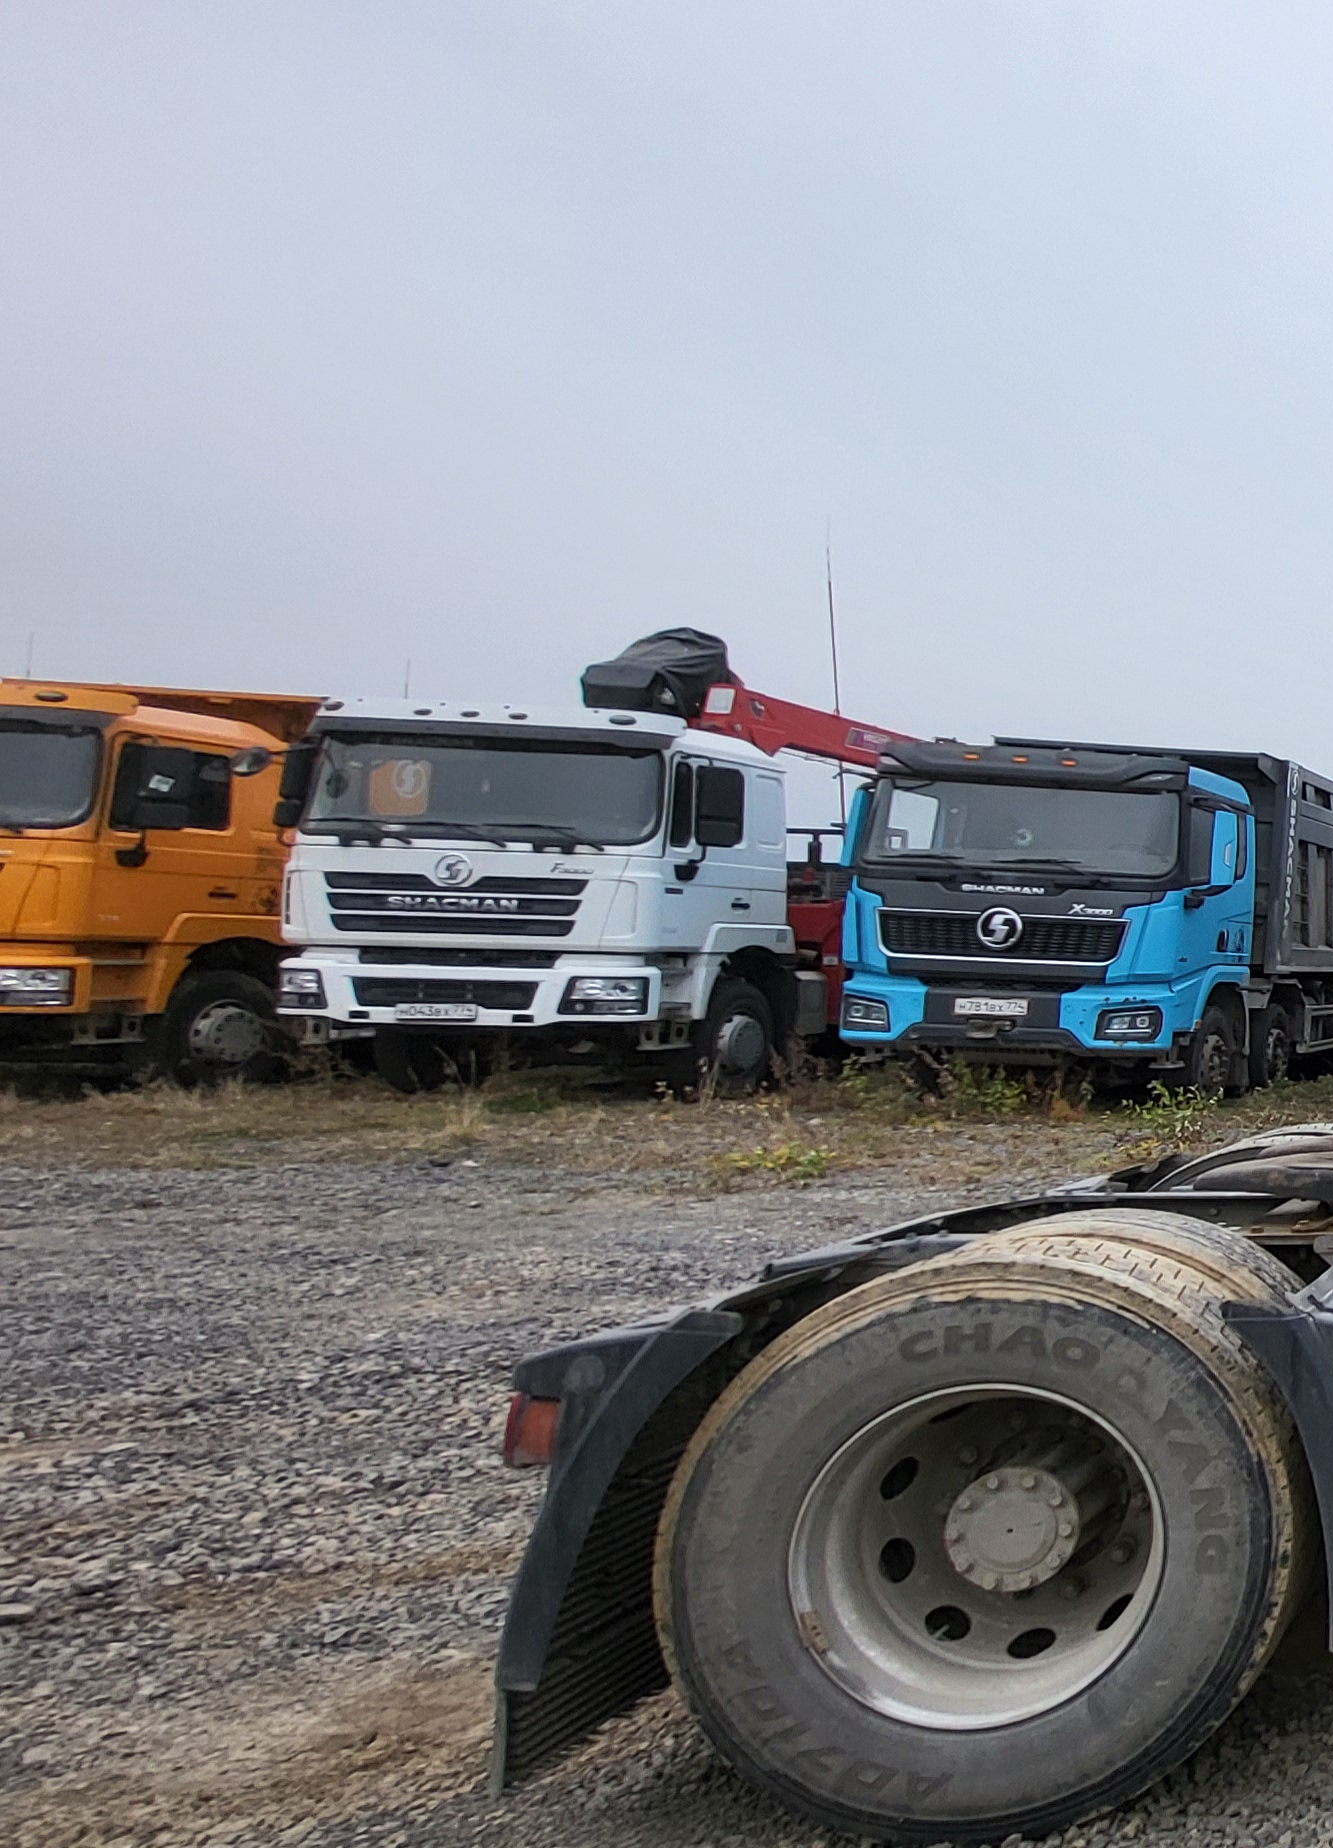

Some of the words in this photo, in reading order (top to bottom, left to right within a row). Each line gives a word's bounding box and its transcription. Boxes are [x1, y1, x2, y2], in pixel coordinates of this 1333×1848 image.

[961, 883, 1045, 895] SHACMAN
[386, 895, 519, 912] SHACMAN
[898, 1321, 1101, 1372] CHAO
[1150, 1396, 1232, 1577] YANG
